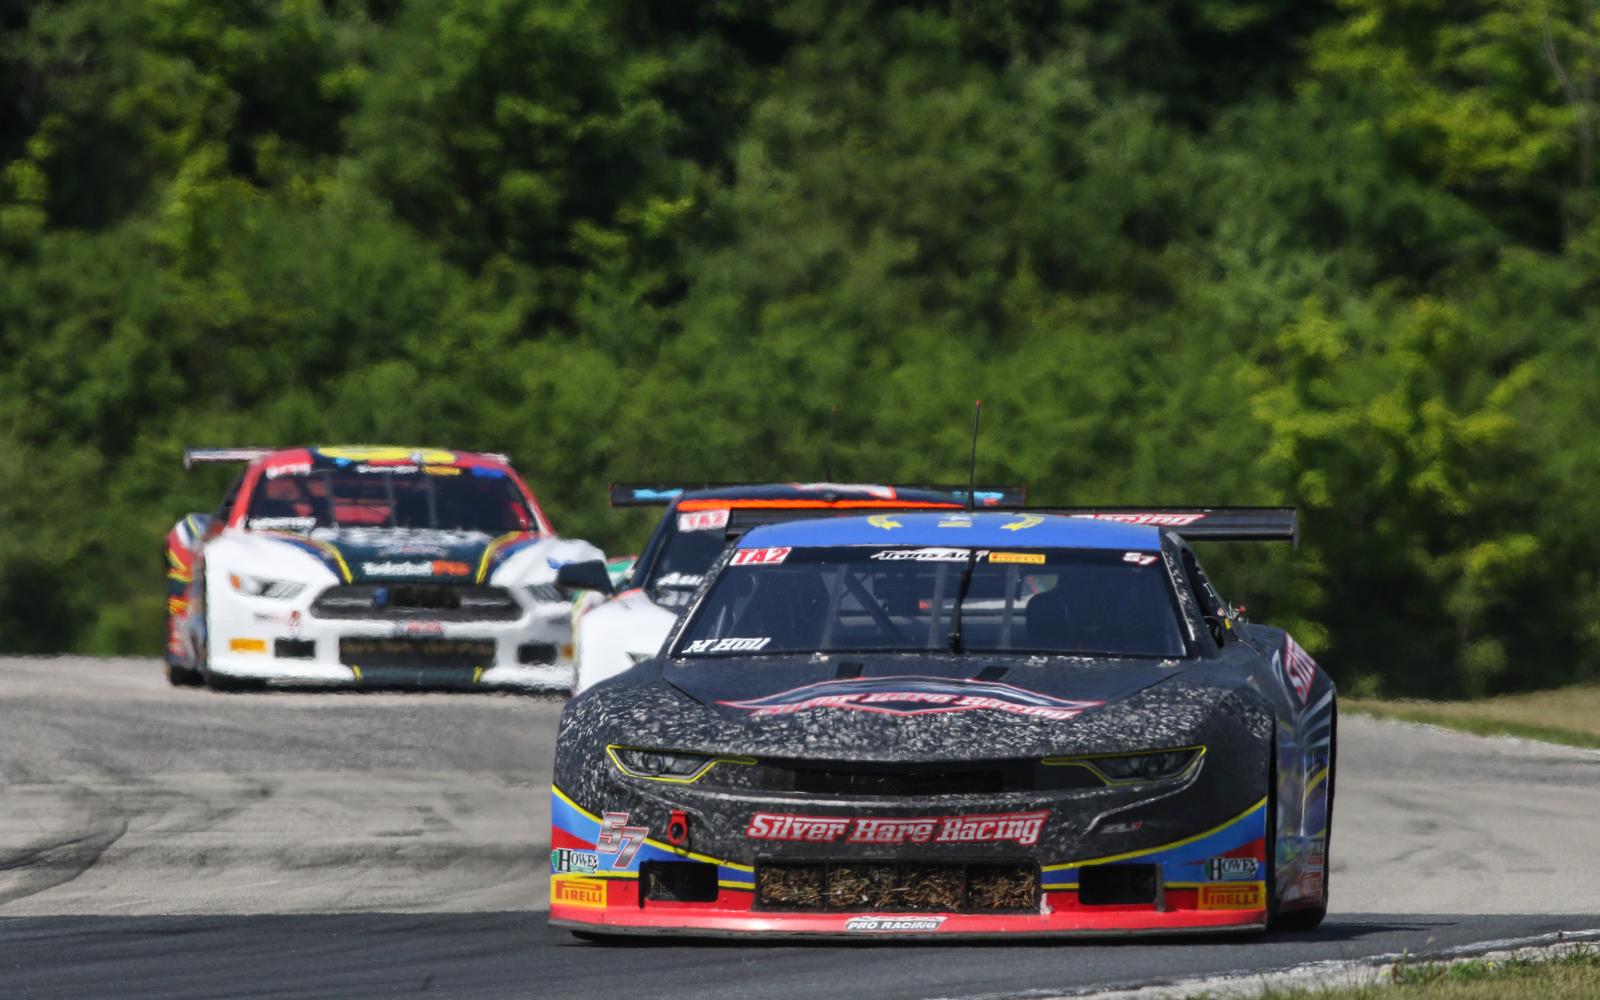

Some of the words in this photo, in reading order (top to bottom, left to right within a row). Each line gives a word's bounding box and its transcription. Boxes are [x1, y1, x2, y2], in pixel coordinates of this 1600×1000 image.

[735, 549, 790, 565] TA2
[1122, 552, 1158, 565] 57
[748, 814, 851, 841] Silver
[850, 817, 938, 842] Hare
[936, 810, 1050, 846] Racing
[597, 812, 649, 869] 57
[556, 880, 603, 903] PIRELLI
[1203, 885, 1259, 905] PIRELLI
[847, 921, 878, 930] PRO
[880, 920, 937, 930] RACING
